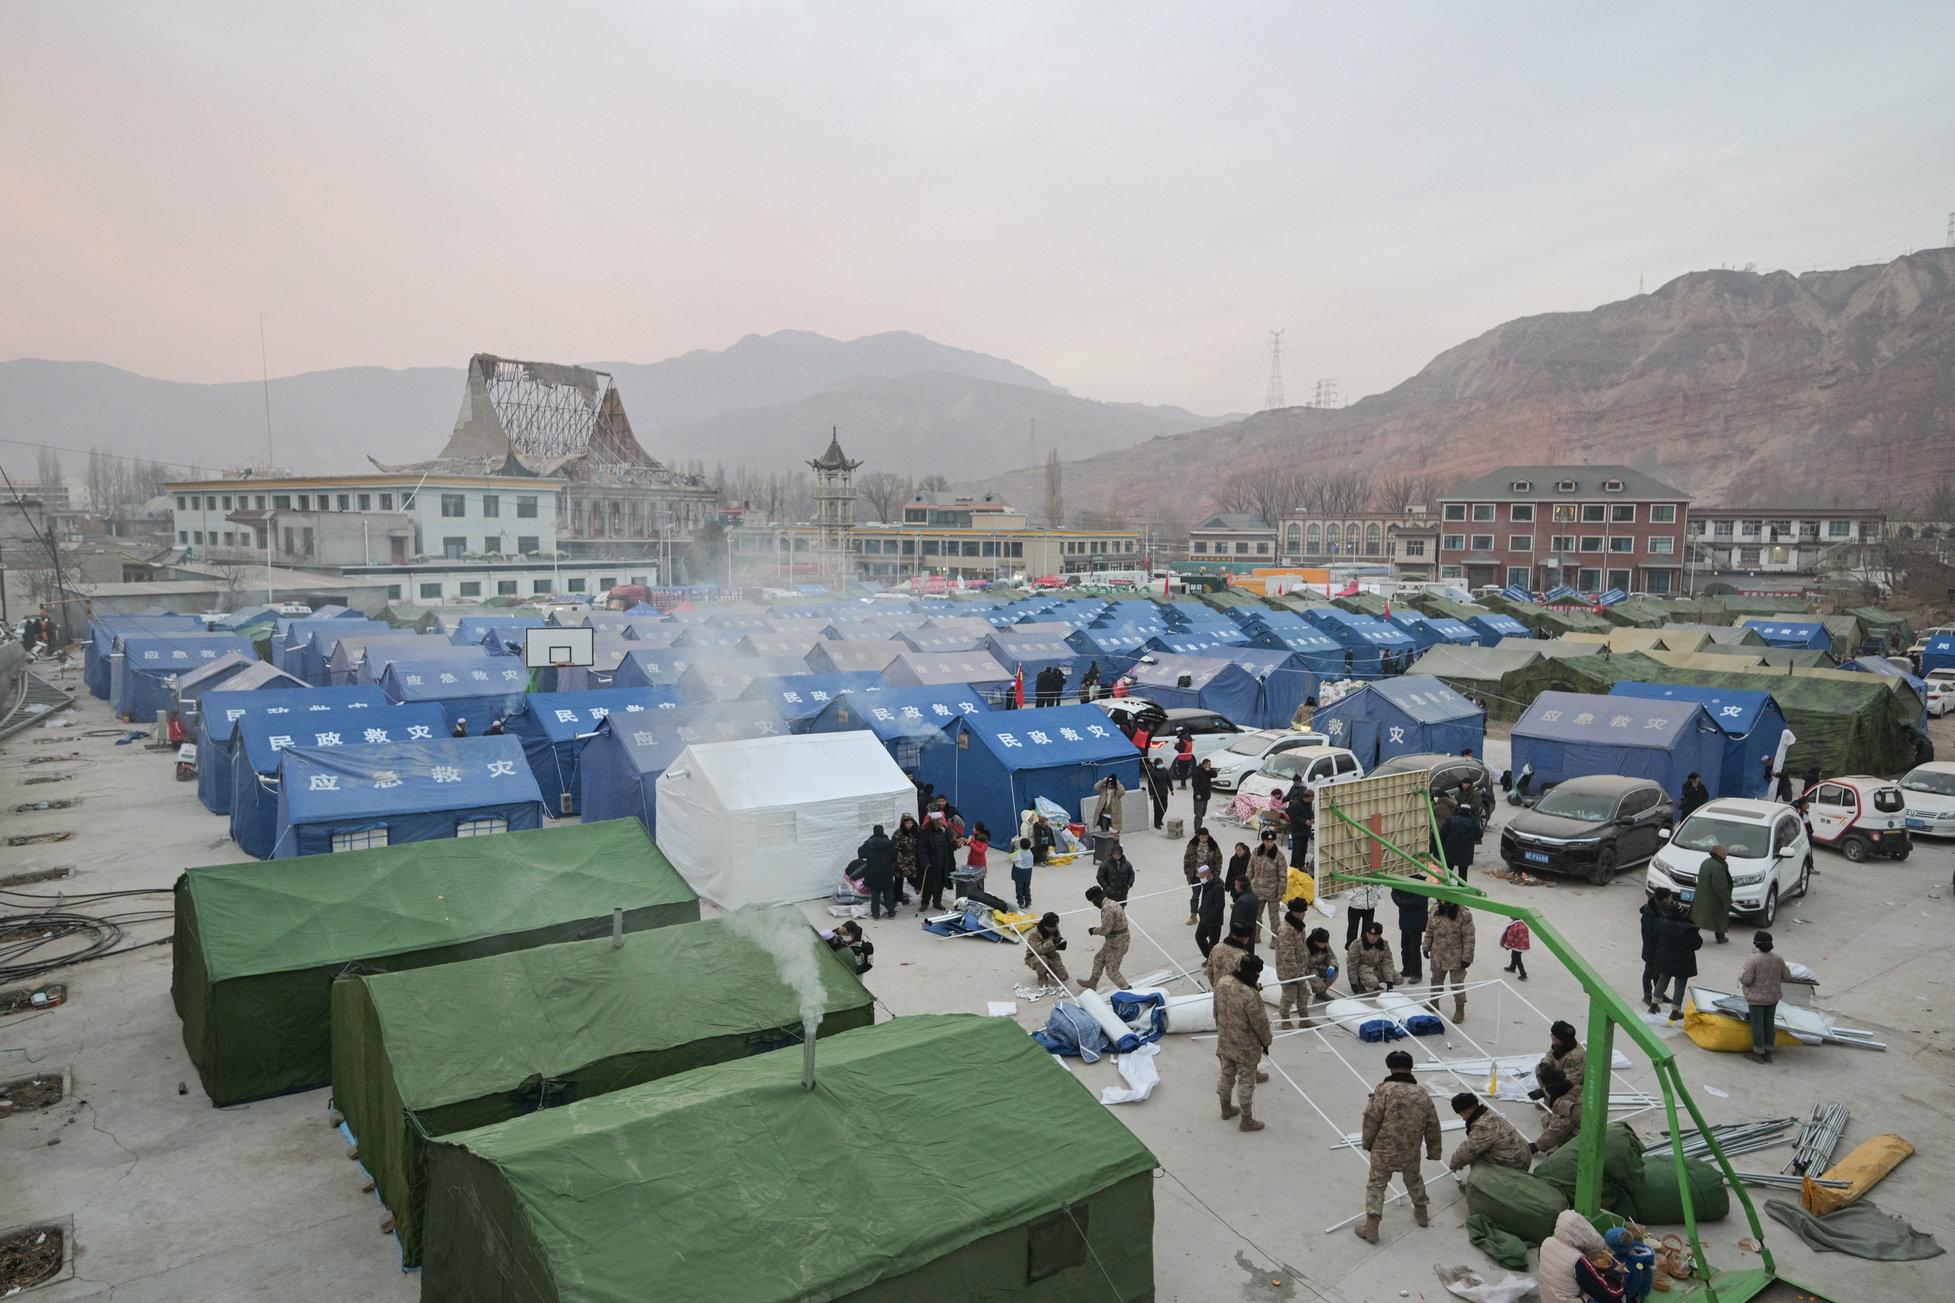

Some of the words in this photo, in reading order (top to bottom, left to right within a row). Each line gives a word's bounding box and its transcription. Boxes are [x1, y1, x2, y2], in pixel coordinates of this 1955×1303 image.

[406, 669, 520, 686] 应急救灾
[872, 701, 979, 722] 民政救灾
[1541, 709, 1668, 730] 应急救灾
[269, 725, 433, 751] 民政救灾
[633, 718, 779, 747] 应急救灾
[997, 723, 1110, 748] 民政救灾
[309, 760, 516, 791] 应急救灾
